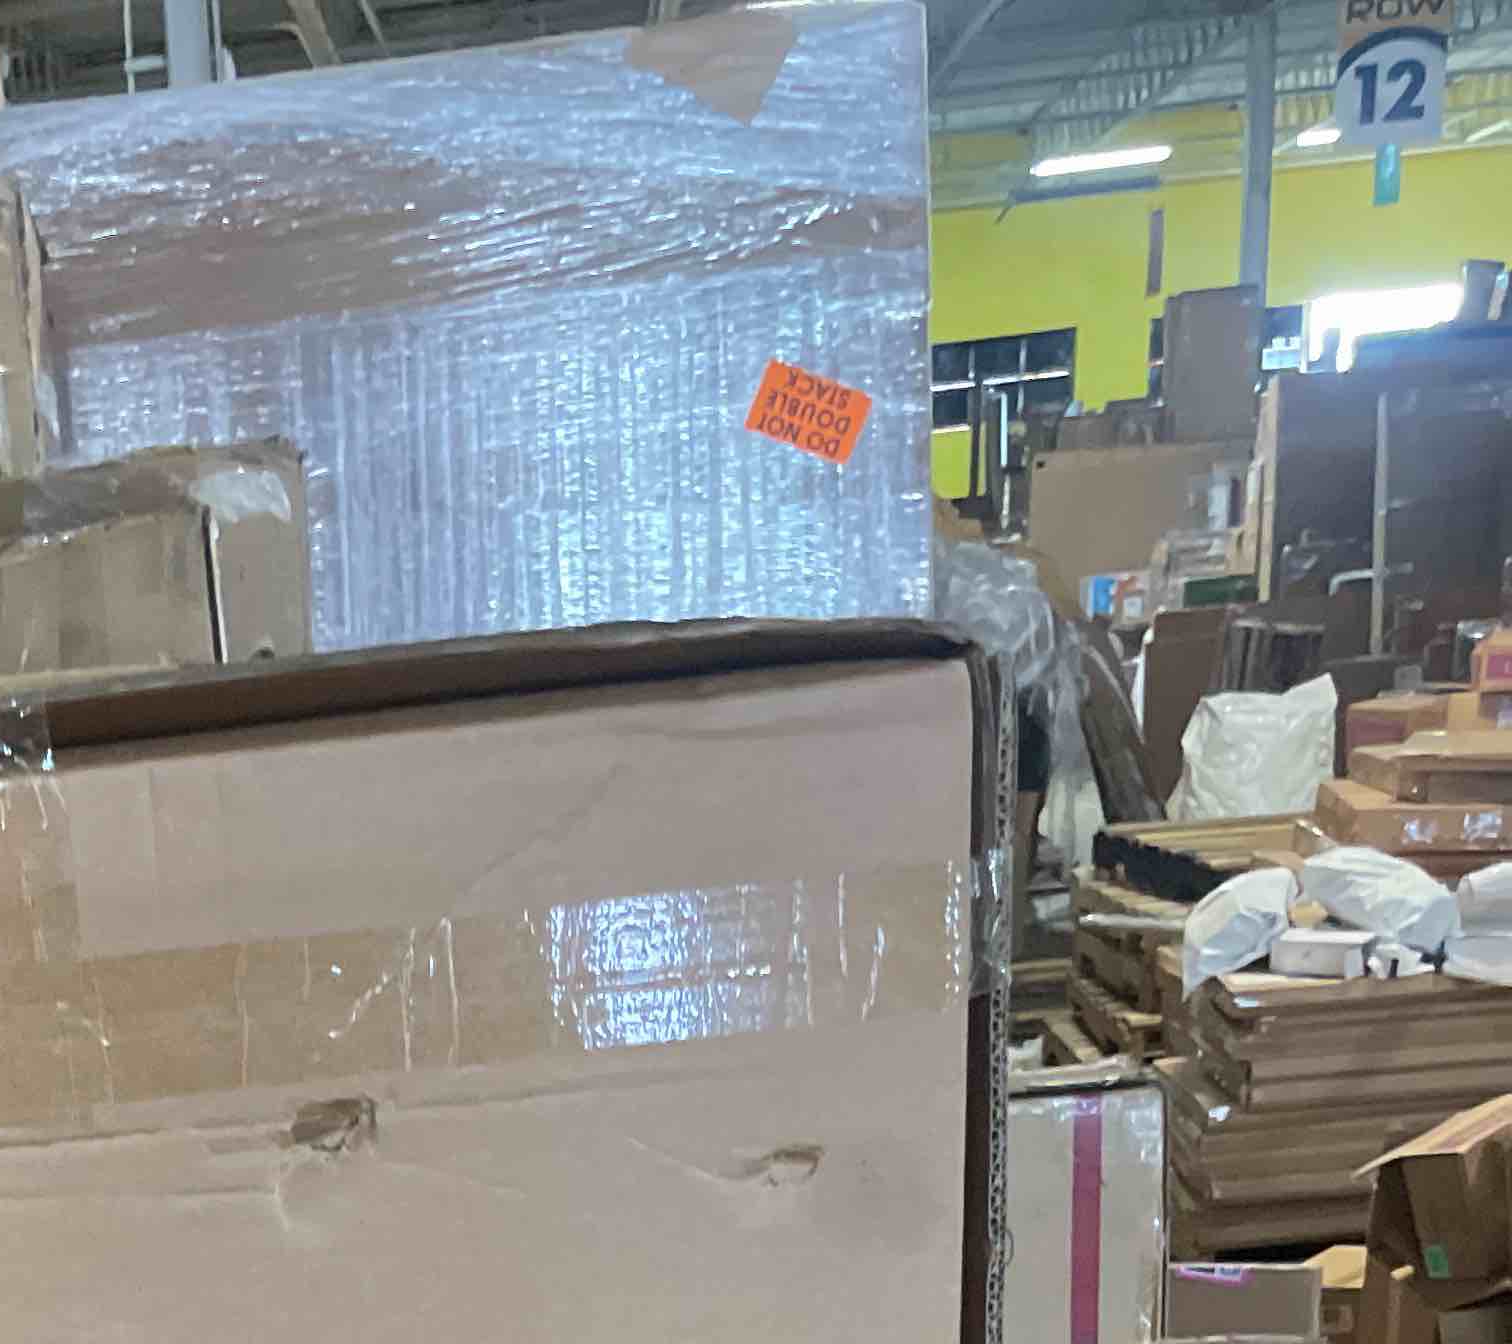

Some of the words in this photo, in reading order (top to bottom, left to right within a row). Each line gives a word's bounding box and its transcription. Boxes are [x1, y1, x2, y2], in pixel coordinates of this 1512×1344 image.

[1345, 0, 1446, 24] ROW
[1354, 59, 1426, 125] 12
[787, 369, 850, 409] STACK
[758, 415, 801, 442] NOT
[767, 390, 850, 434] DOUBLE
[807, 431, 840, 458] DO
